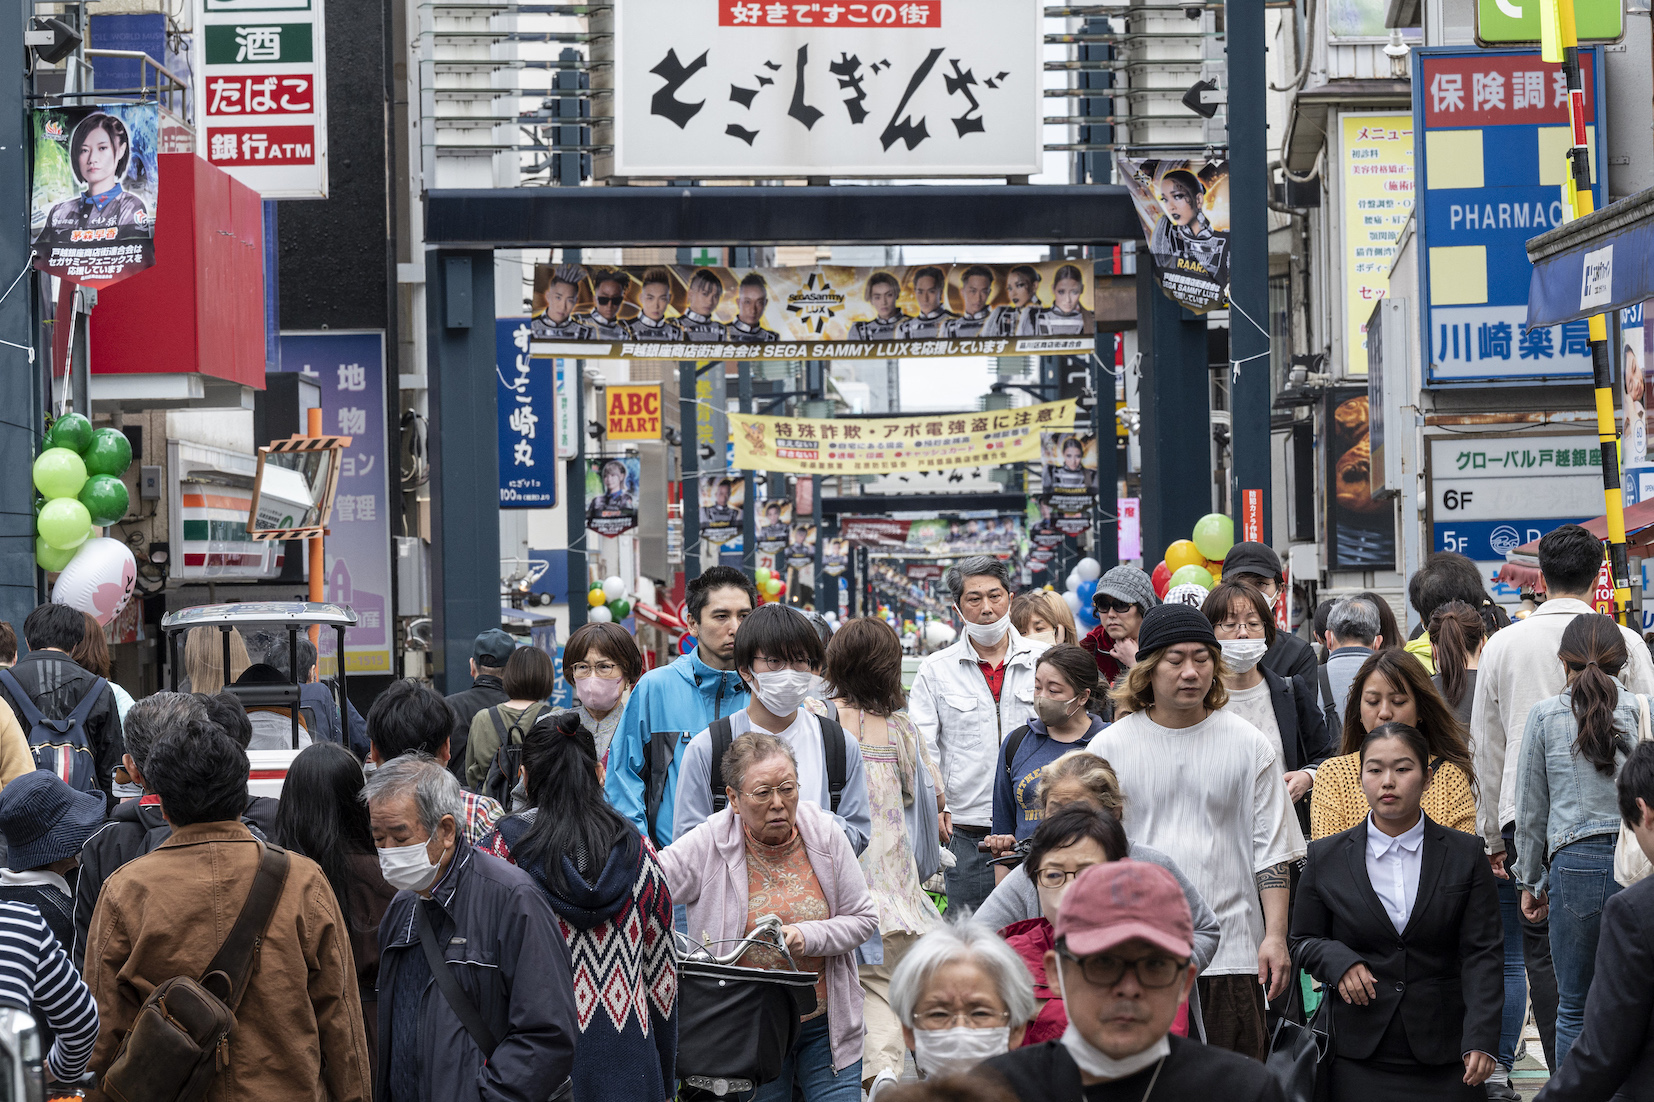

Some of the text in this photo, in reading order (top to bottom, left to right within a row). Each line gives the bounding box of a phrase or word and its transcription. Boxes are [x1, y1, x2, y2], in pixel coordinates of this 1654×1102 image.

[730, 2, 931, 25] 好きですこの街
[235, 26, 283, 62] 酒
[209, 77, 311, 113] たばこ
[648, 43, 1011, 153] とごしぎんざ
[1430, 69, 1586, 113] 保険調剤
[1356, 127, 1413, 141] メニュー
[1351, 149, 1379, 159] 初診料
[1357, 200, 1411, 209] 骨盤調整・O
[1450, 201, 1563, 231] PHARMAC
[1359, 286, 1386, 300] セッ
[620, 343, 761, 359] 戸越銀座商店街連合会は
[763, 343, 808, 358] SEGA
[812, 342, 875, 358] SAMMY
[1438, 321, 1592, 362] 川崎薬局
[609, 392, 659, 416] ABC
[338, 406, 367, 435] 物
[609, 417, 659, 433] MART
[1455, 449, 1604, 471] グローバル戸越銀座
[1443, 489, 1473, 510] 6F
[1443, 530, 1469, 553] 5F
